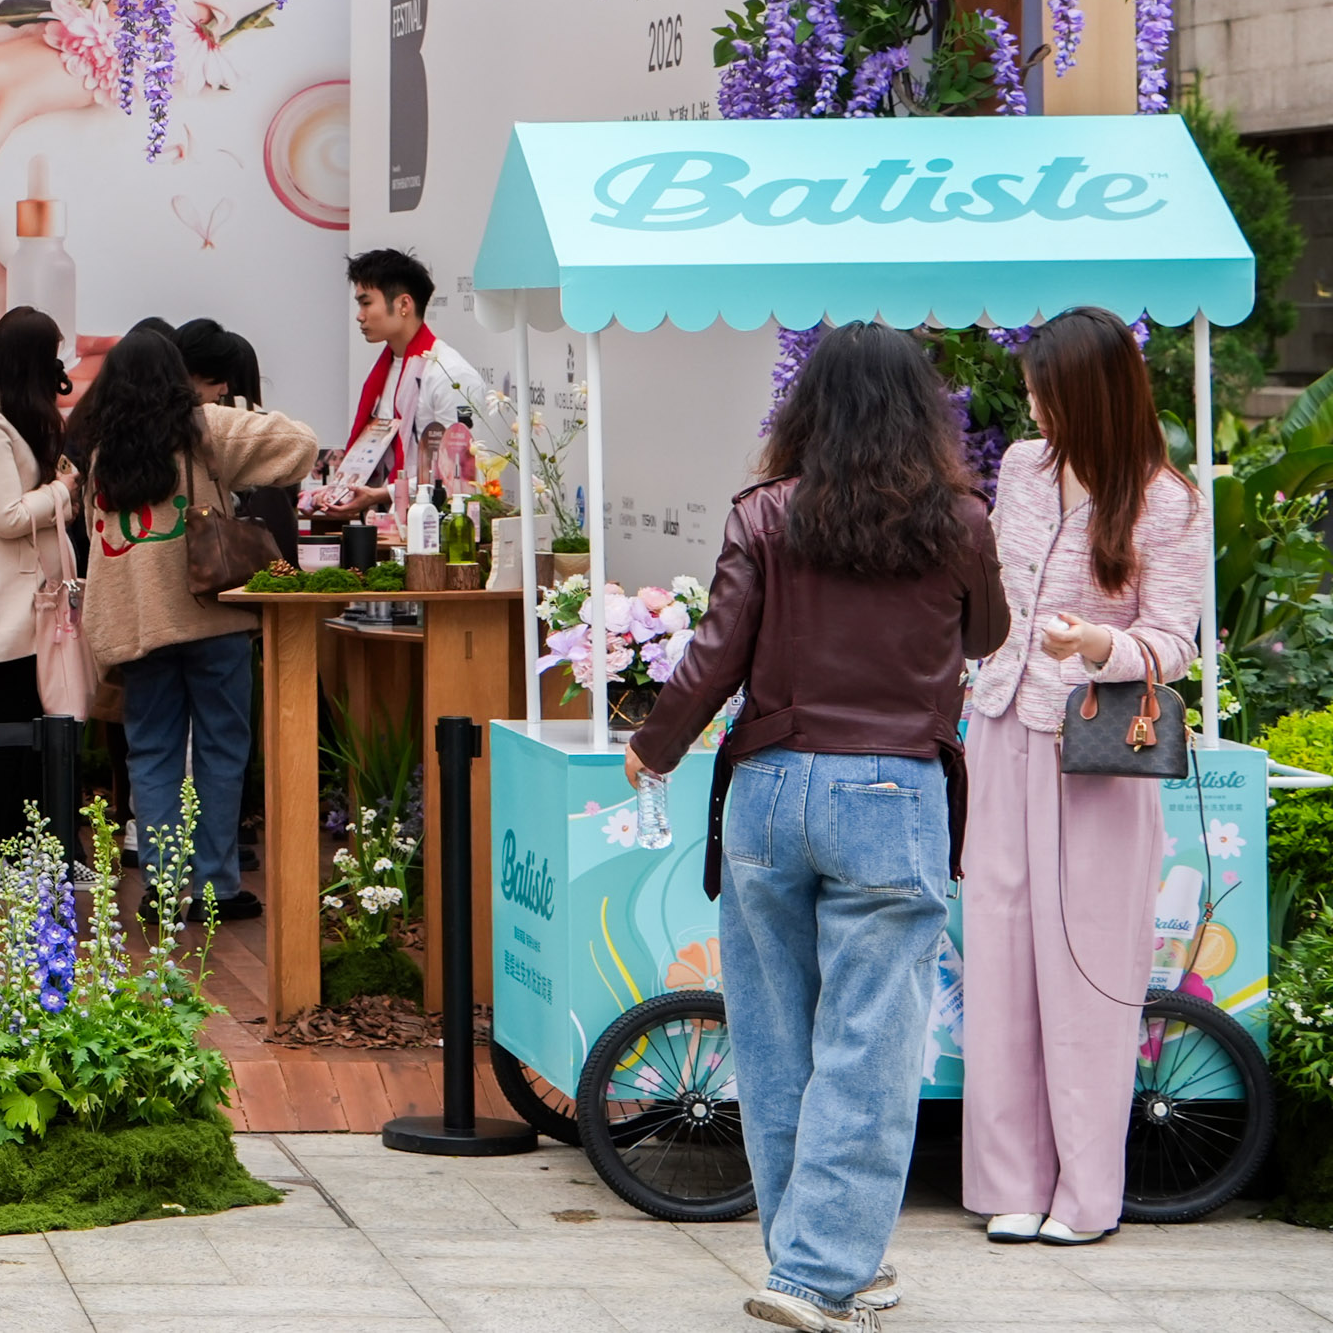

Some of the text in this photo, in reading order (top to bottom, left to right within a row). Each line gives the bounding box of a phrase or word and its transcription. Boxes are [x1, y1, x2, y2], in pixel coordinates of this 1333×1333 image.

[648, 14, 683, 72] 2026
[589, 150, 1169, 232] Batiste
[501, 829, 555, 921] Batiste
